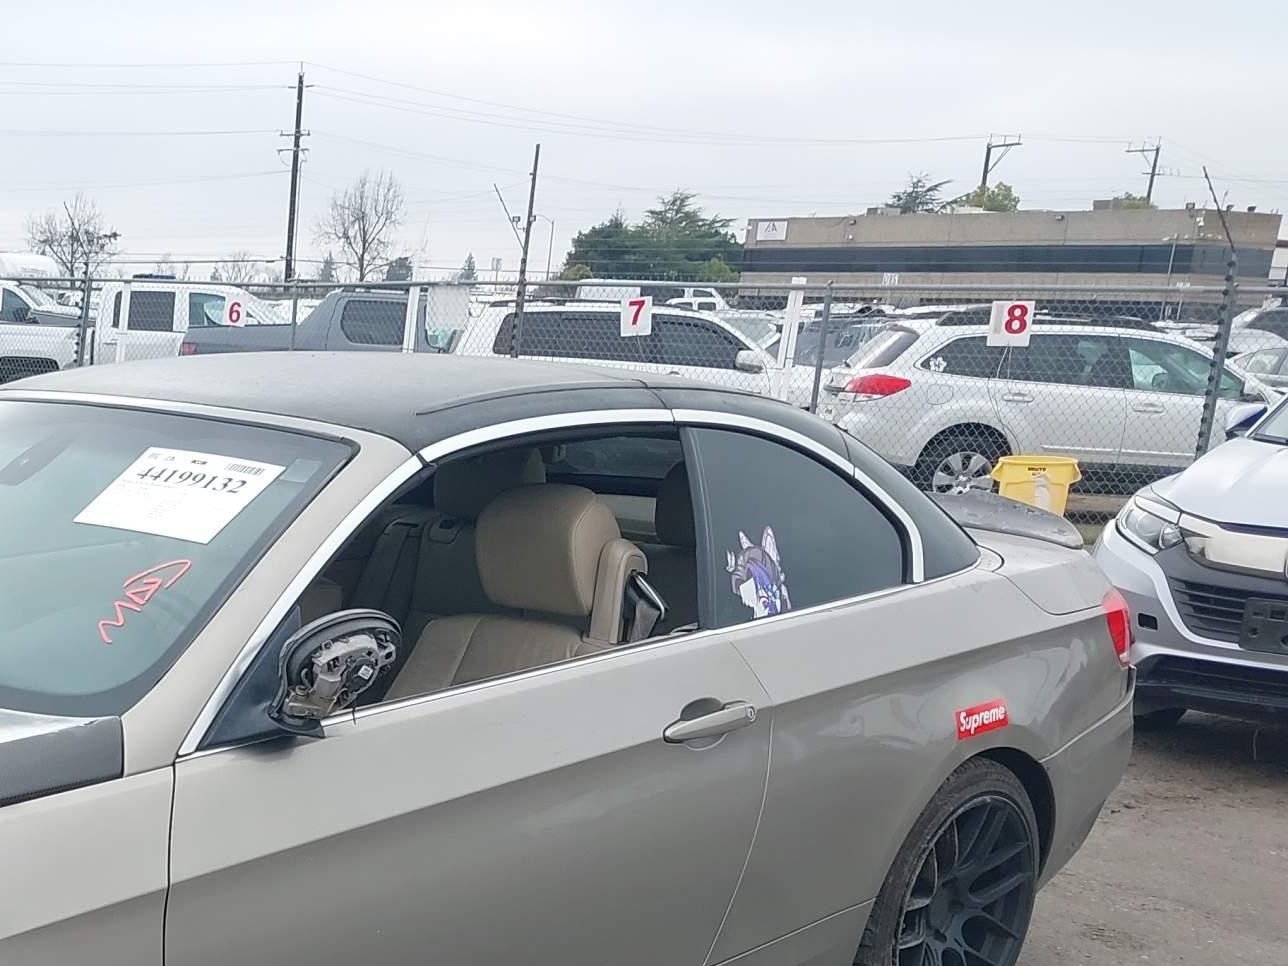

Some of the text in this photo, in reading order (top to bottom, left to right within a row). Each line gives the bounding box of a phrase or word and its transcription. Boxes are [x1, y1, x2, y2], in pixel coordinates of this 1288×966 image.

[228, 301, 242, 323] 6
[629, 299, 646, 326] 7
[1004, 304, 1028, 335] 8
[136, 465, 248, 494] 44199132
[959, 706, 1005, 735] Supreme
